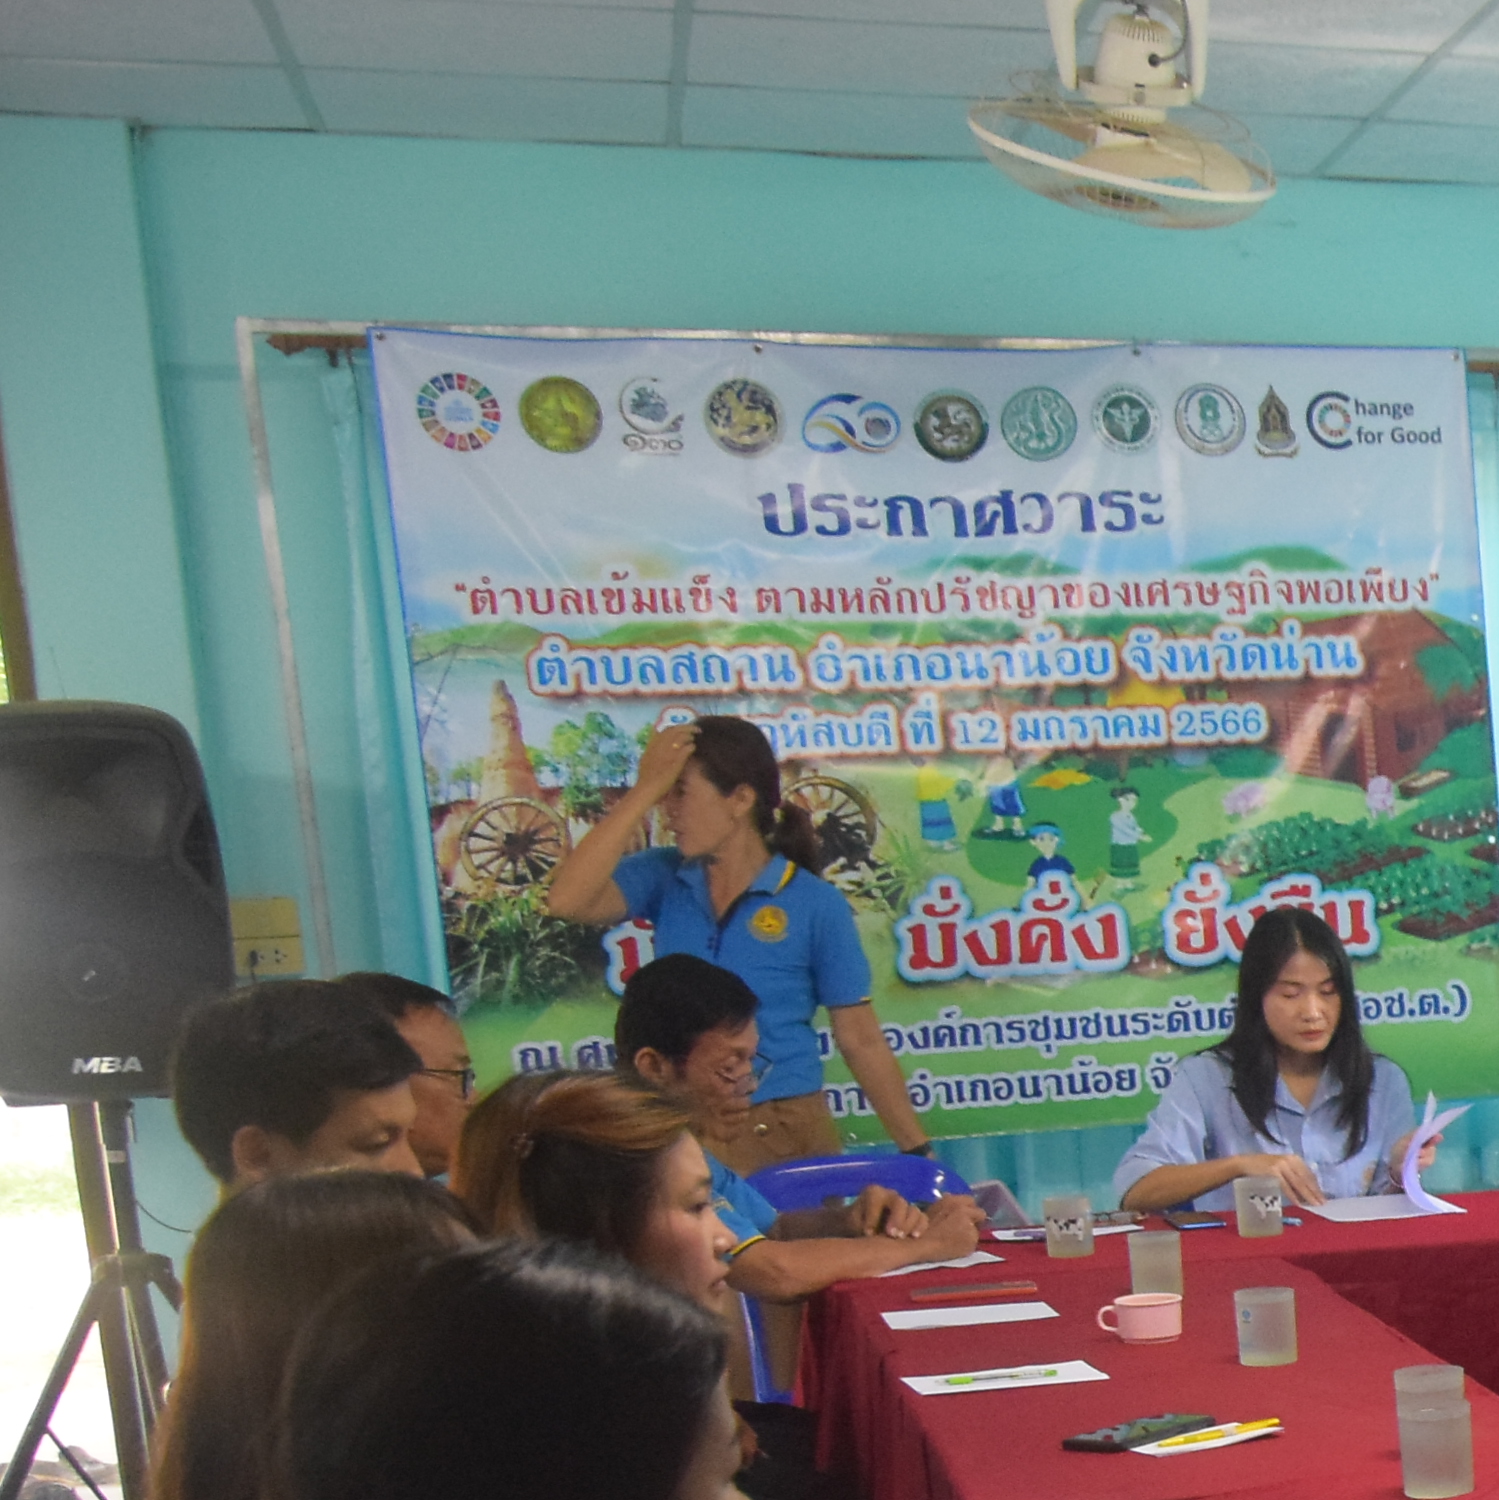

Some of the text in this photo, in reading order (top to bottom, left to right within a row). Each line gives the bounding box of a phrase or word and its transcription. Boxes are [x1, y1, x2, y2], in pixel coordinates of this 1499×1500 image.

[1356, 426, 1442, 444] for Good
[757, 483, 1166, 538] ประกาศวาระ
[537, 622, 1358, 687] ตำบลสถาน อำเภอนาน้อย จังหวัดน่าน
[909, 698, 936, 746] ที่
[956, 716, 998, 746] 12
[1016, 709, 1162, 741] มกราคม
[1176, 705, 1264, 738] 2566
[908, 880, 1120, 970] มั่งคั่ง
[72, 1056, 143, 1074] MBA
[908, 1060, 1137, 1108] อำเภอนาน้อย
